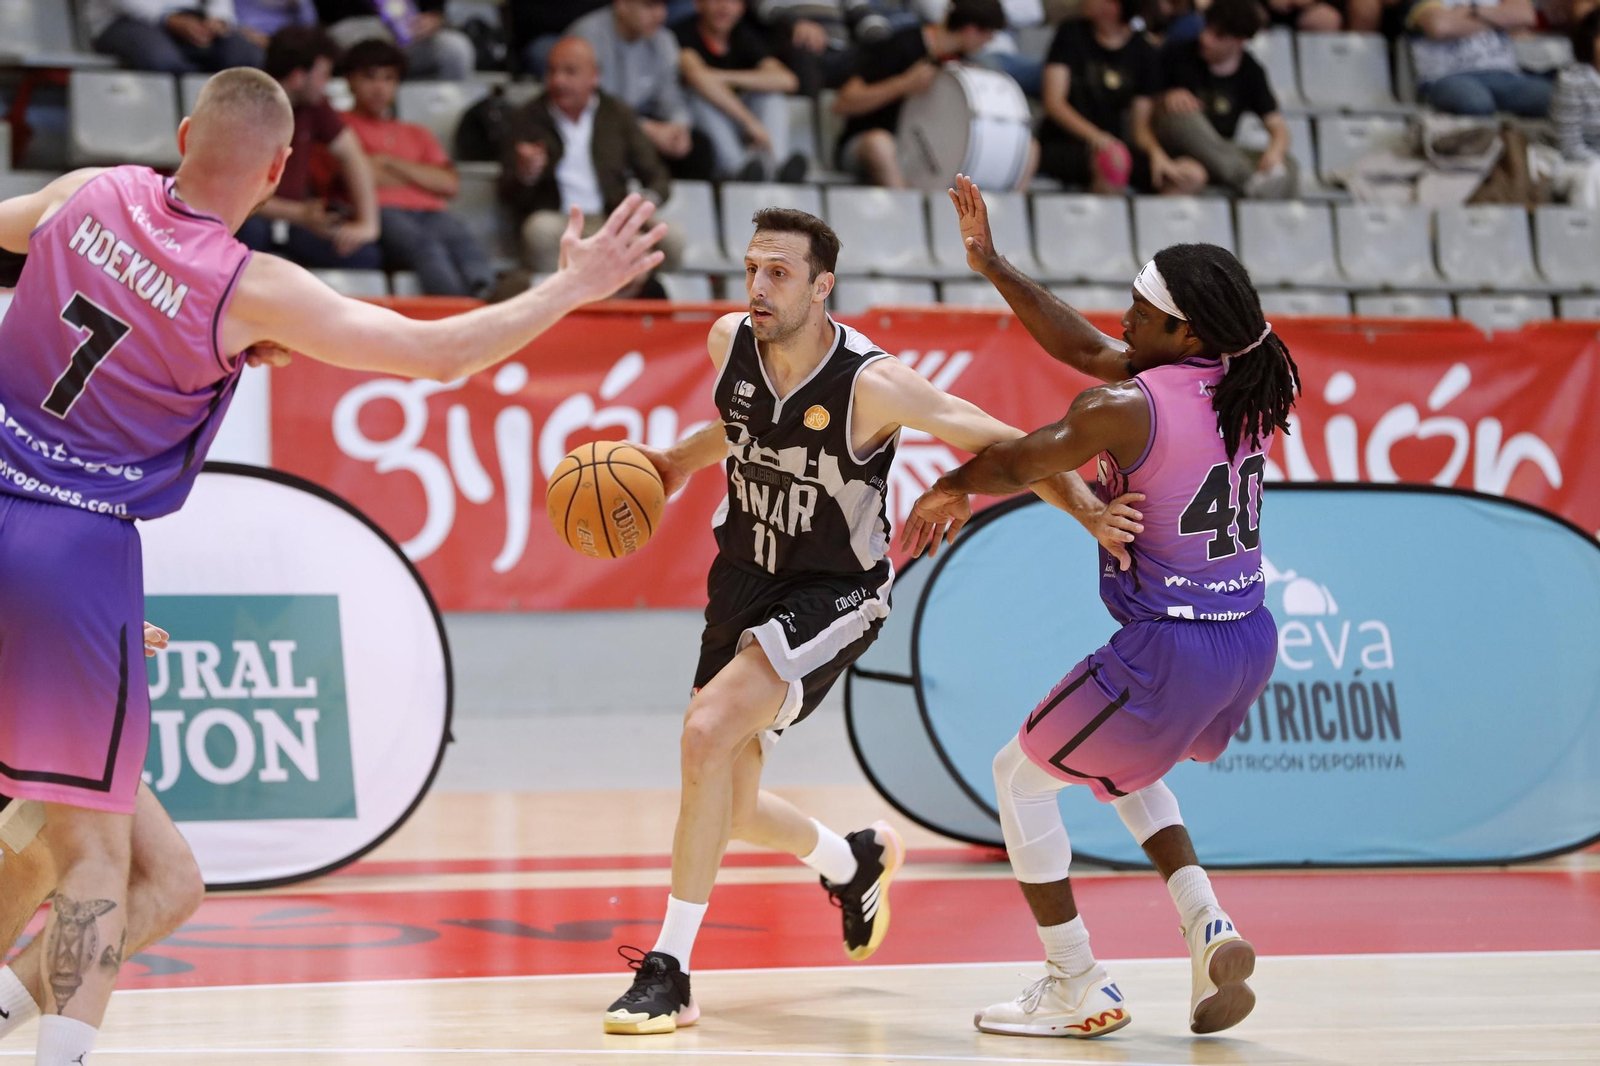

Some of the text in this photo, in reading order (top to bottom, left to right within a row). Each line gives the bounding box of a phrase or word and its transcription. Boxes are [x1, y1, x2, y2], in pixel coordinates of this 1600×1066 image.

[68, 214, 190, 321] HOEKUM
[40, 290, 133, 420] 7
[752, 521, 777, 575] 11
[1178, 452, 1266, 561] 40
[1308, 751, 1406, 772] DEPORTIVA
